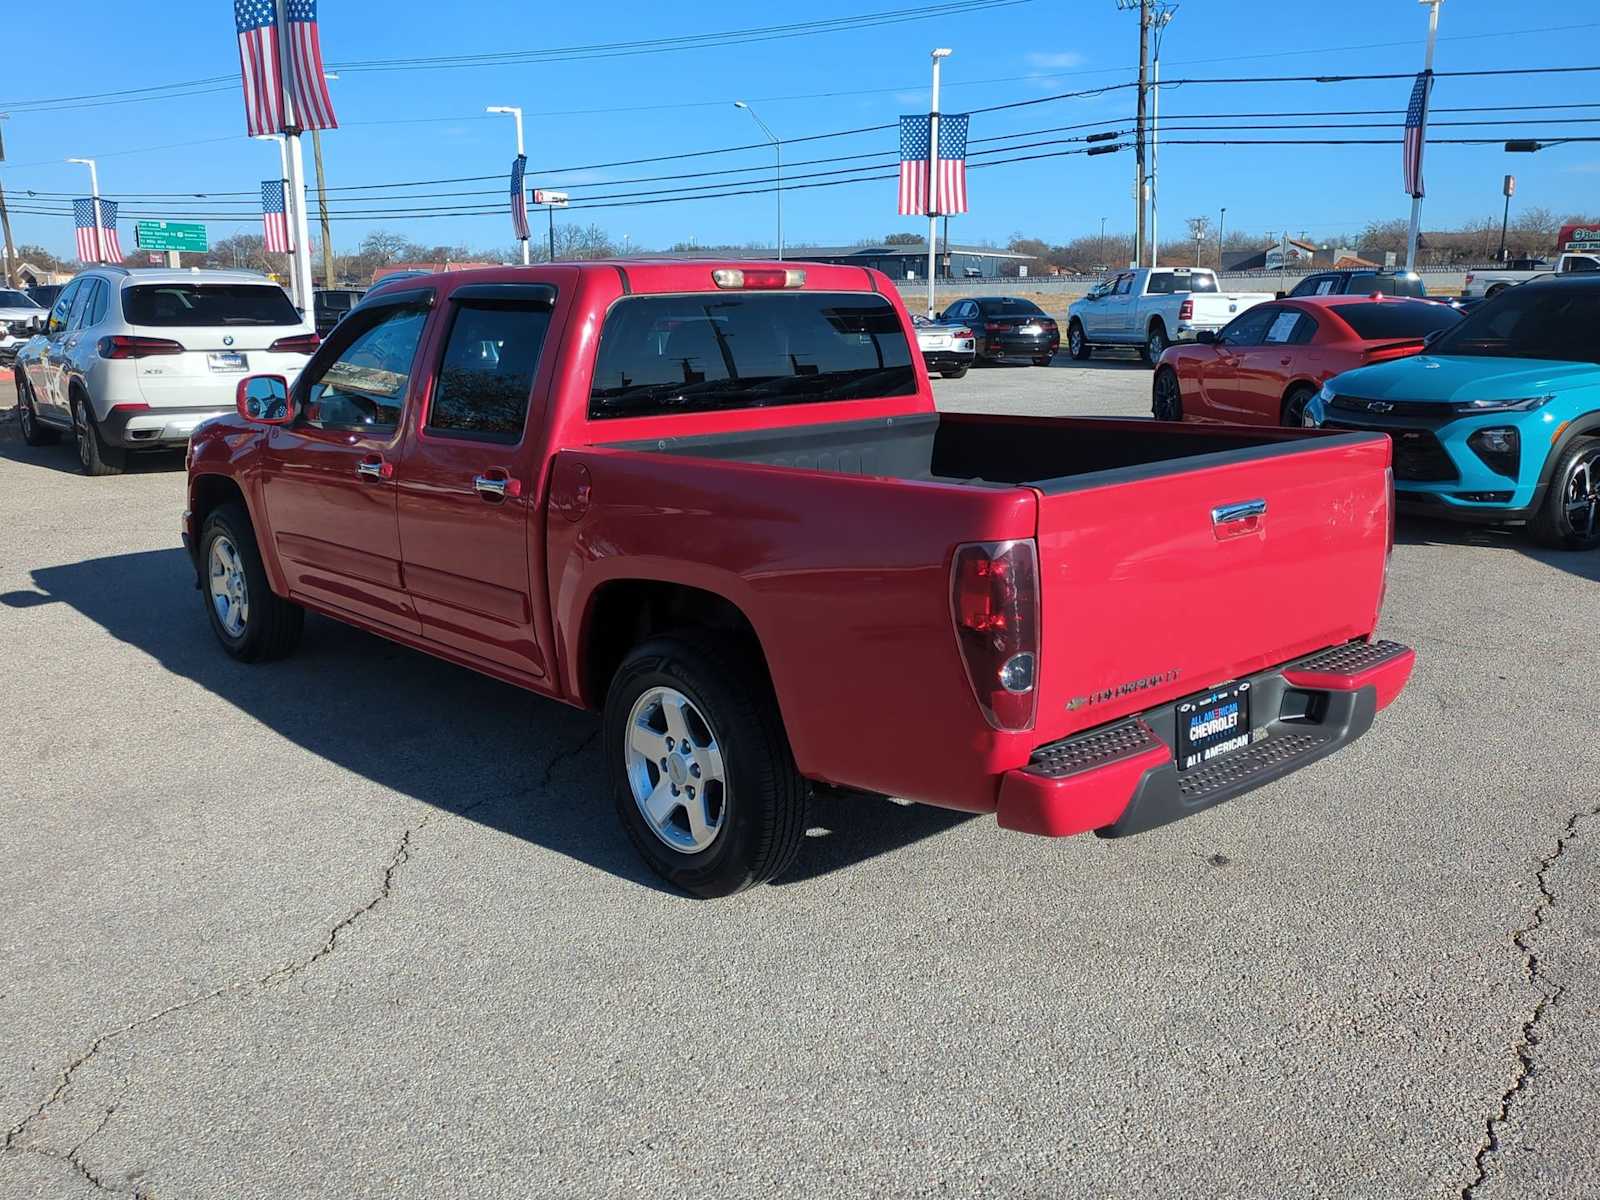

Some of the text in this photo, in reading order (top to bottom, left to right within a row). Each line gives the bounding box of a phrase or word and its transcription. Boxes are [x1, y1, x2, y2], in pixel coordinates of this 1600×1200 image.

[1189, 711, 1238, 742] CHEVROLET
[1190, 702, 1238, 727] ALL AMERICAN
[1204, 734, 1249, 761] AMERICAN
